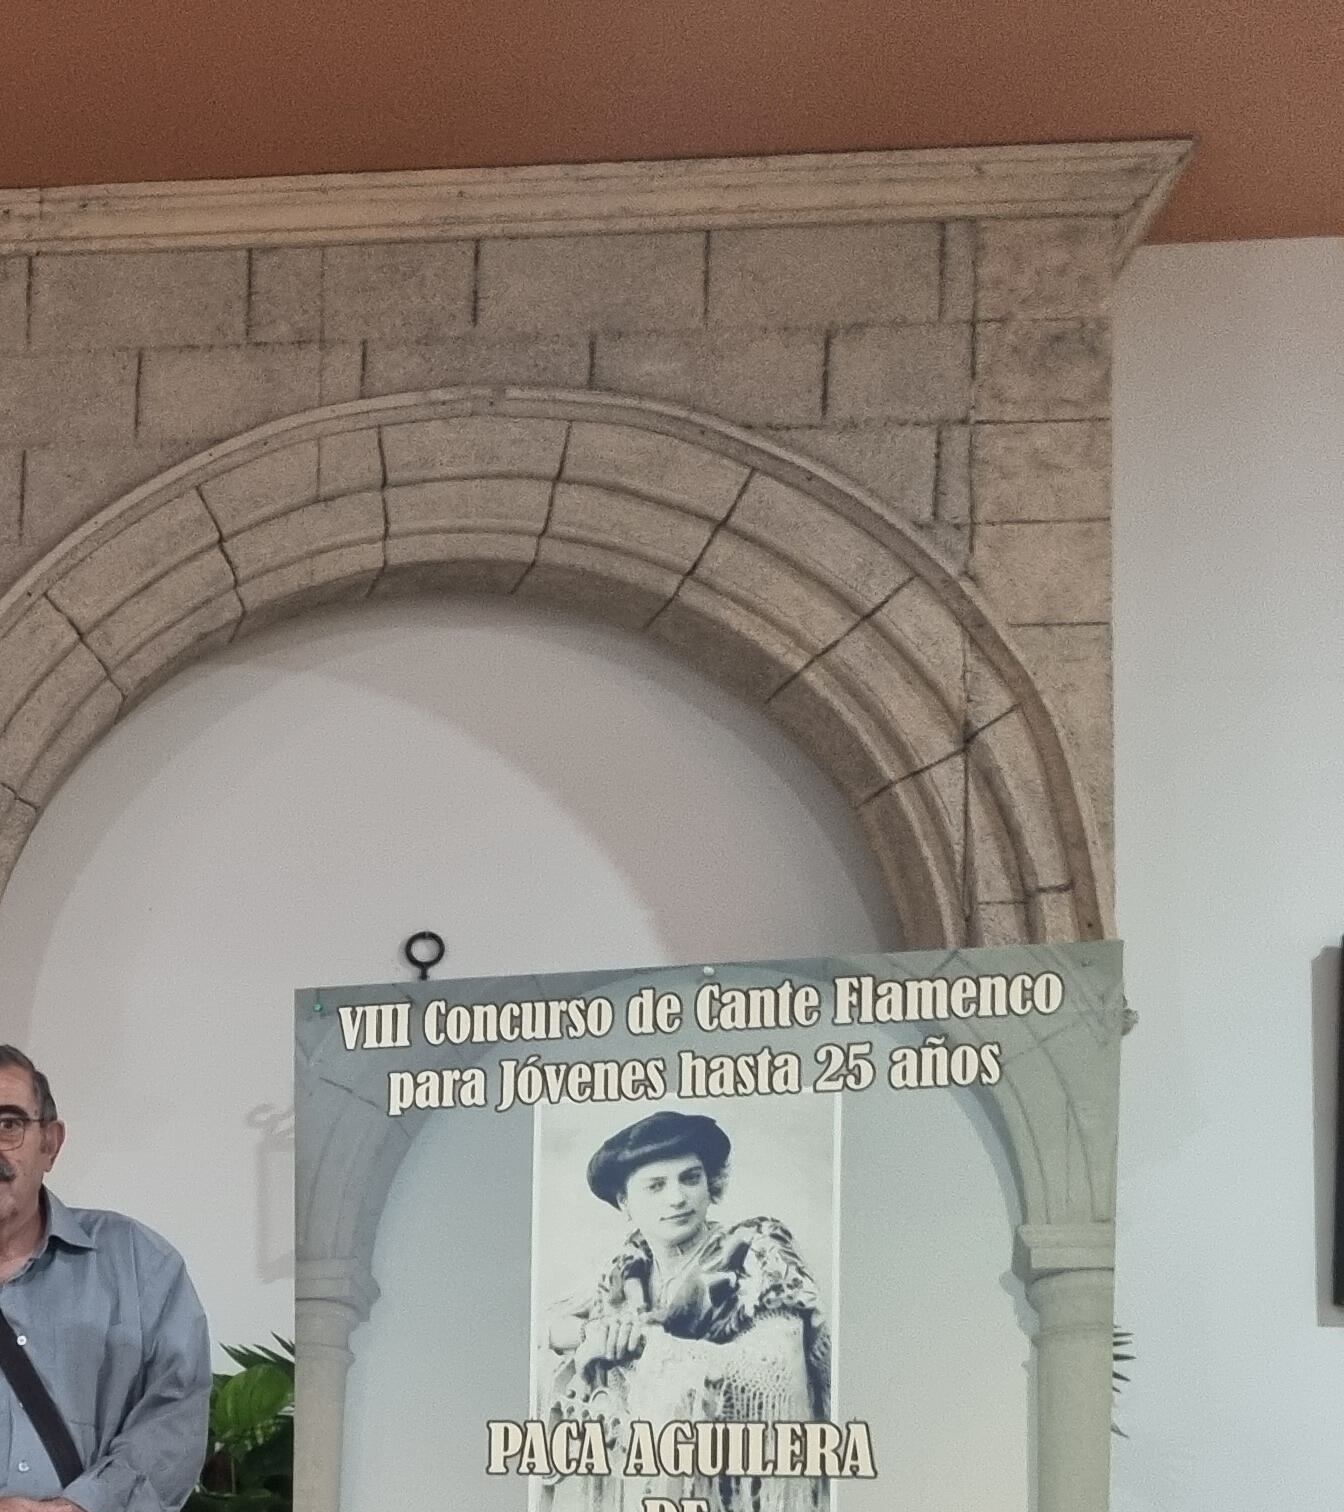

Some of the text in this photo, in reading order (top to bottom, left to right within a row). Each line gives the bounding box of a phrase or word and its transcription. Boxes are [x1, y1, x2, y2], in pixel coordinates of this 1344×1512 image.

[339, 972, 1064, 1050] VIII Concurso de Cante Flamenco
[387, 1035, 1003, 1117] para Jóvenes hasta 25 años
[486, 1419, 878, 1479] PACA AGUILERA
